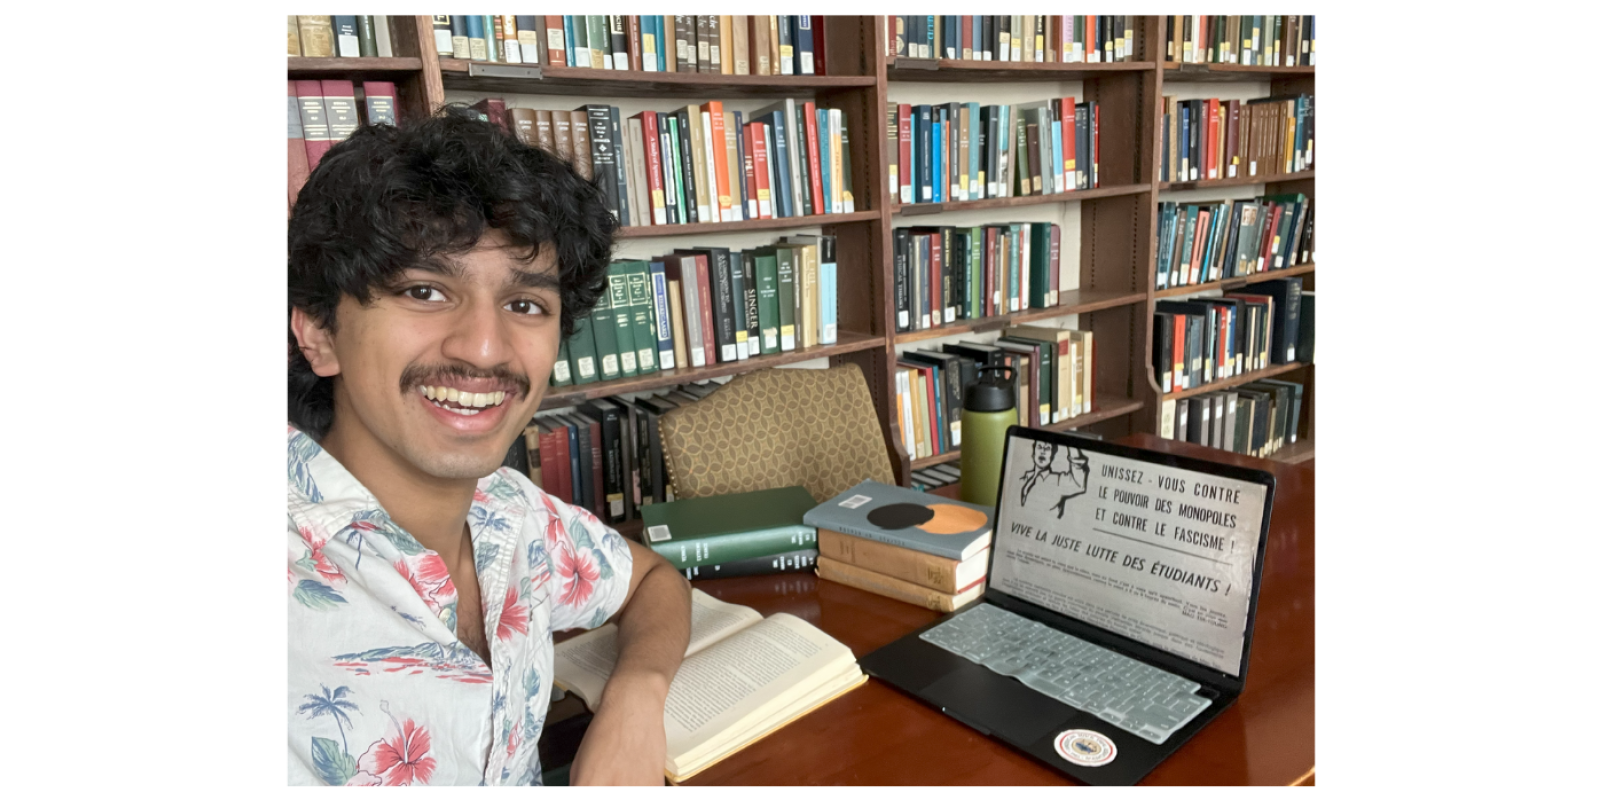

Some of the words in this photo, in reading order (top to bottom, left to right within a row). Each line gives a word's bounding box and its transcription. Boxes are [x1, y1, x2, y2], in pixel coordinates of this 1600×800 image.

[748, 289, 758, 329] SINGER
[1101, 464, 1143, 484] UNISSEZ
[1158, 475, 1186, 493] VOUS
[1193, 482, 1241, 504] CONTRE
[1098, 485, 1108, 499] LE
[1113, 489, 1149, 508] POUVOIR
[1155, 498, 1172, 514] DES
[1178, 503, 1237, 529] MONOPOLES
[1095, 508, 1106, 521] ET
[1112, 512, 1148, 532] CONTRE
[1155, 522, 1167, 536] LE
[1174, 526, 1225, 551] FASCISME
[1011, 521, 1033, 538] VIVE
[1035, 529, 1048, 542] LA
[1051, 534, 1082, 552] JUSTE
[1086, 544, 1119, 563] LUTTE
[1122, 554, 1146, 571] DES
[1150, 560, 1221, 592] ÉTUDIANTS
